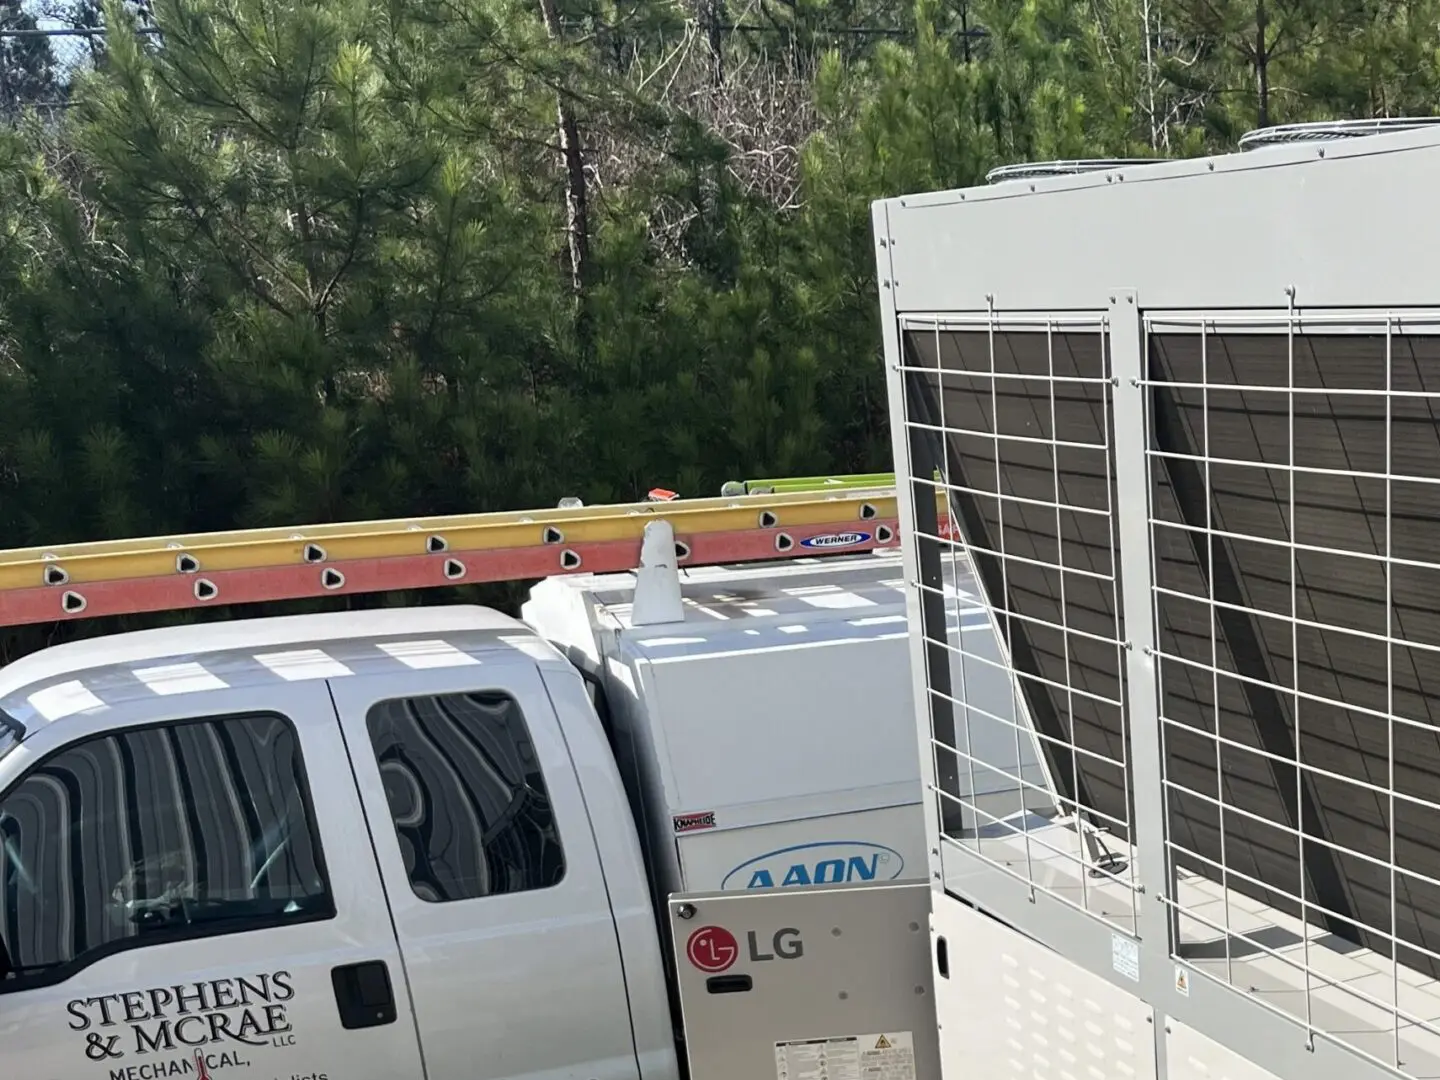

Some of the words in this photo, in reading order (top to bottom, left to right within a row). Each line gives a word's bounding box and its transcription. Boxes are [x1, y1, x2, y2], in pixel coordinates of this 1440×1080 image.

[815, 535, 858, 545] WERNER
[746, 853, 879, 889] AAON
[747, 927, 804, 961] LG
[66, 970, 295, 1031] STEPHENS
[85, 1032, 124, 1061] &
[131, 1004, 293, 1054] MCRAE
[272, 1034, 297, 1048] LLC
